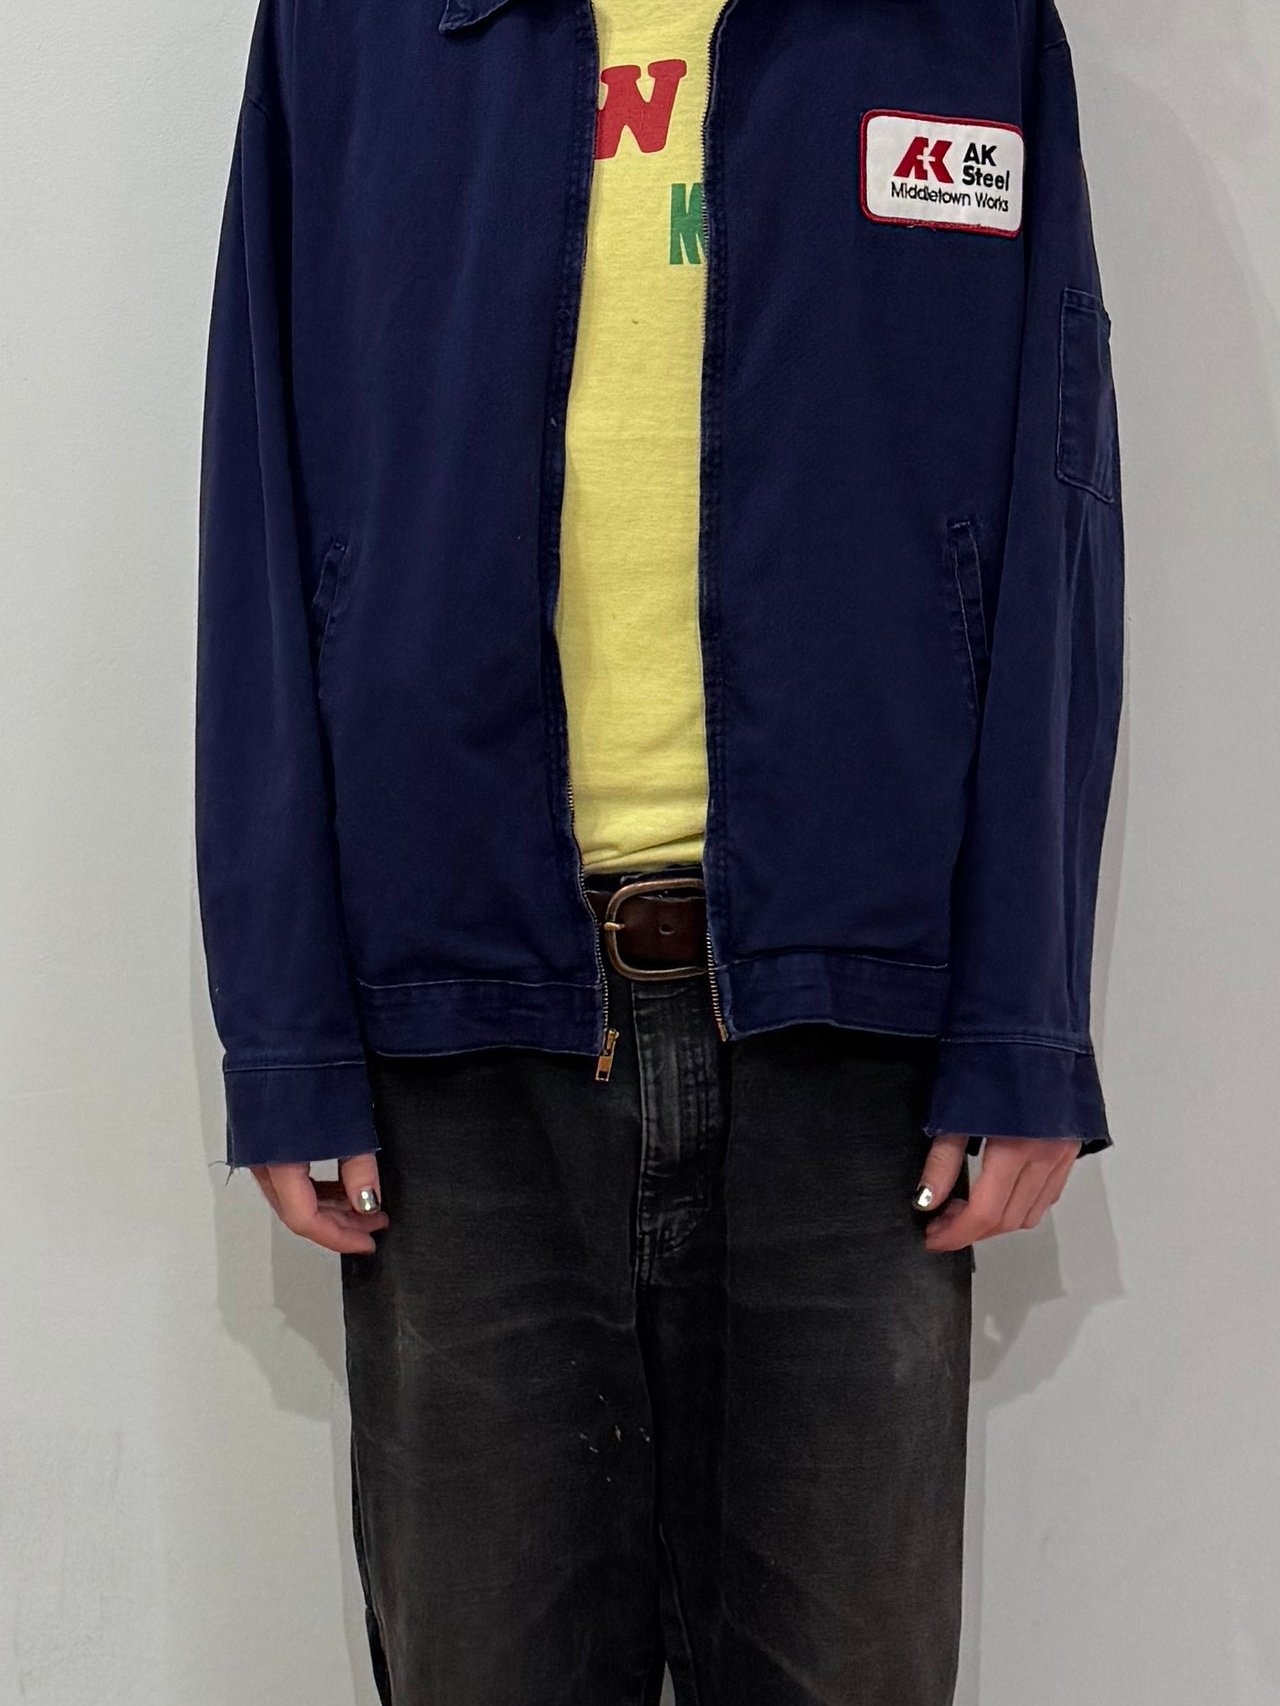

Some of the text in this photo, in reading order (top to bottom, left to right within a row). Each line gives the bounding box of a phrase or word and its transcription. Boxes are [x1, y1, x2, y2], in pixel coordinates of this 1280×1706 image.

[963, 142, 997, 166] AK
[962, 165, 1010, 191] Steel
[891, 181, 1009, 212] Middletown Works
